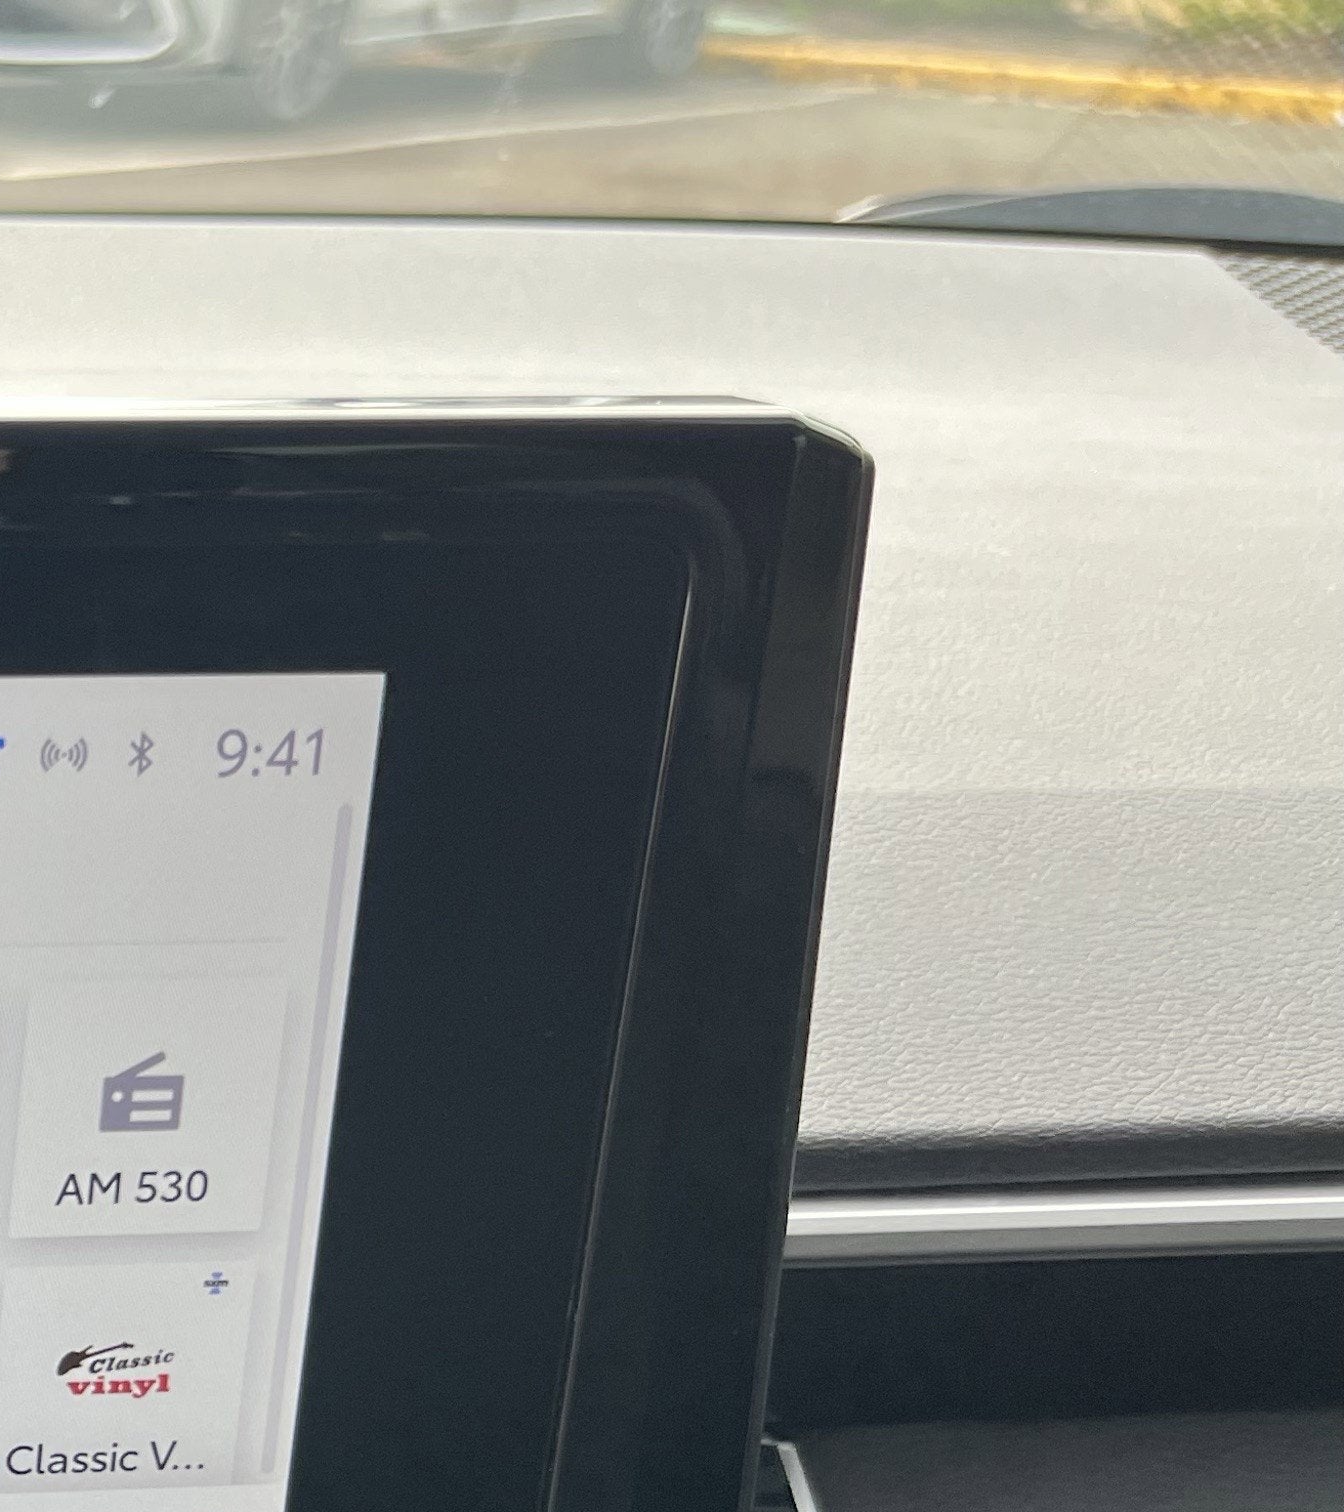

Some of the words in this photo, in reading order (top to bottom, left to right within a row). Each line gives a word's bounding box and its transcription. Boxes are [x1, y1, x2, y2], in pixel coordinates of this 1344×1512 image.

[215, 727, 325, 779] 9:41
[55, 1171, 122, 1207] AM
[135, 1169, 210, 1204] 530
[89, 1349, 175, 1374] Classic
[67, 1374, 170, 1398] vinyl
[5, 1442, 139, 1477] Classic
